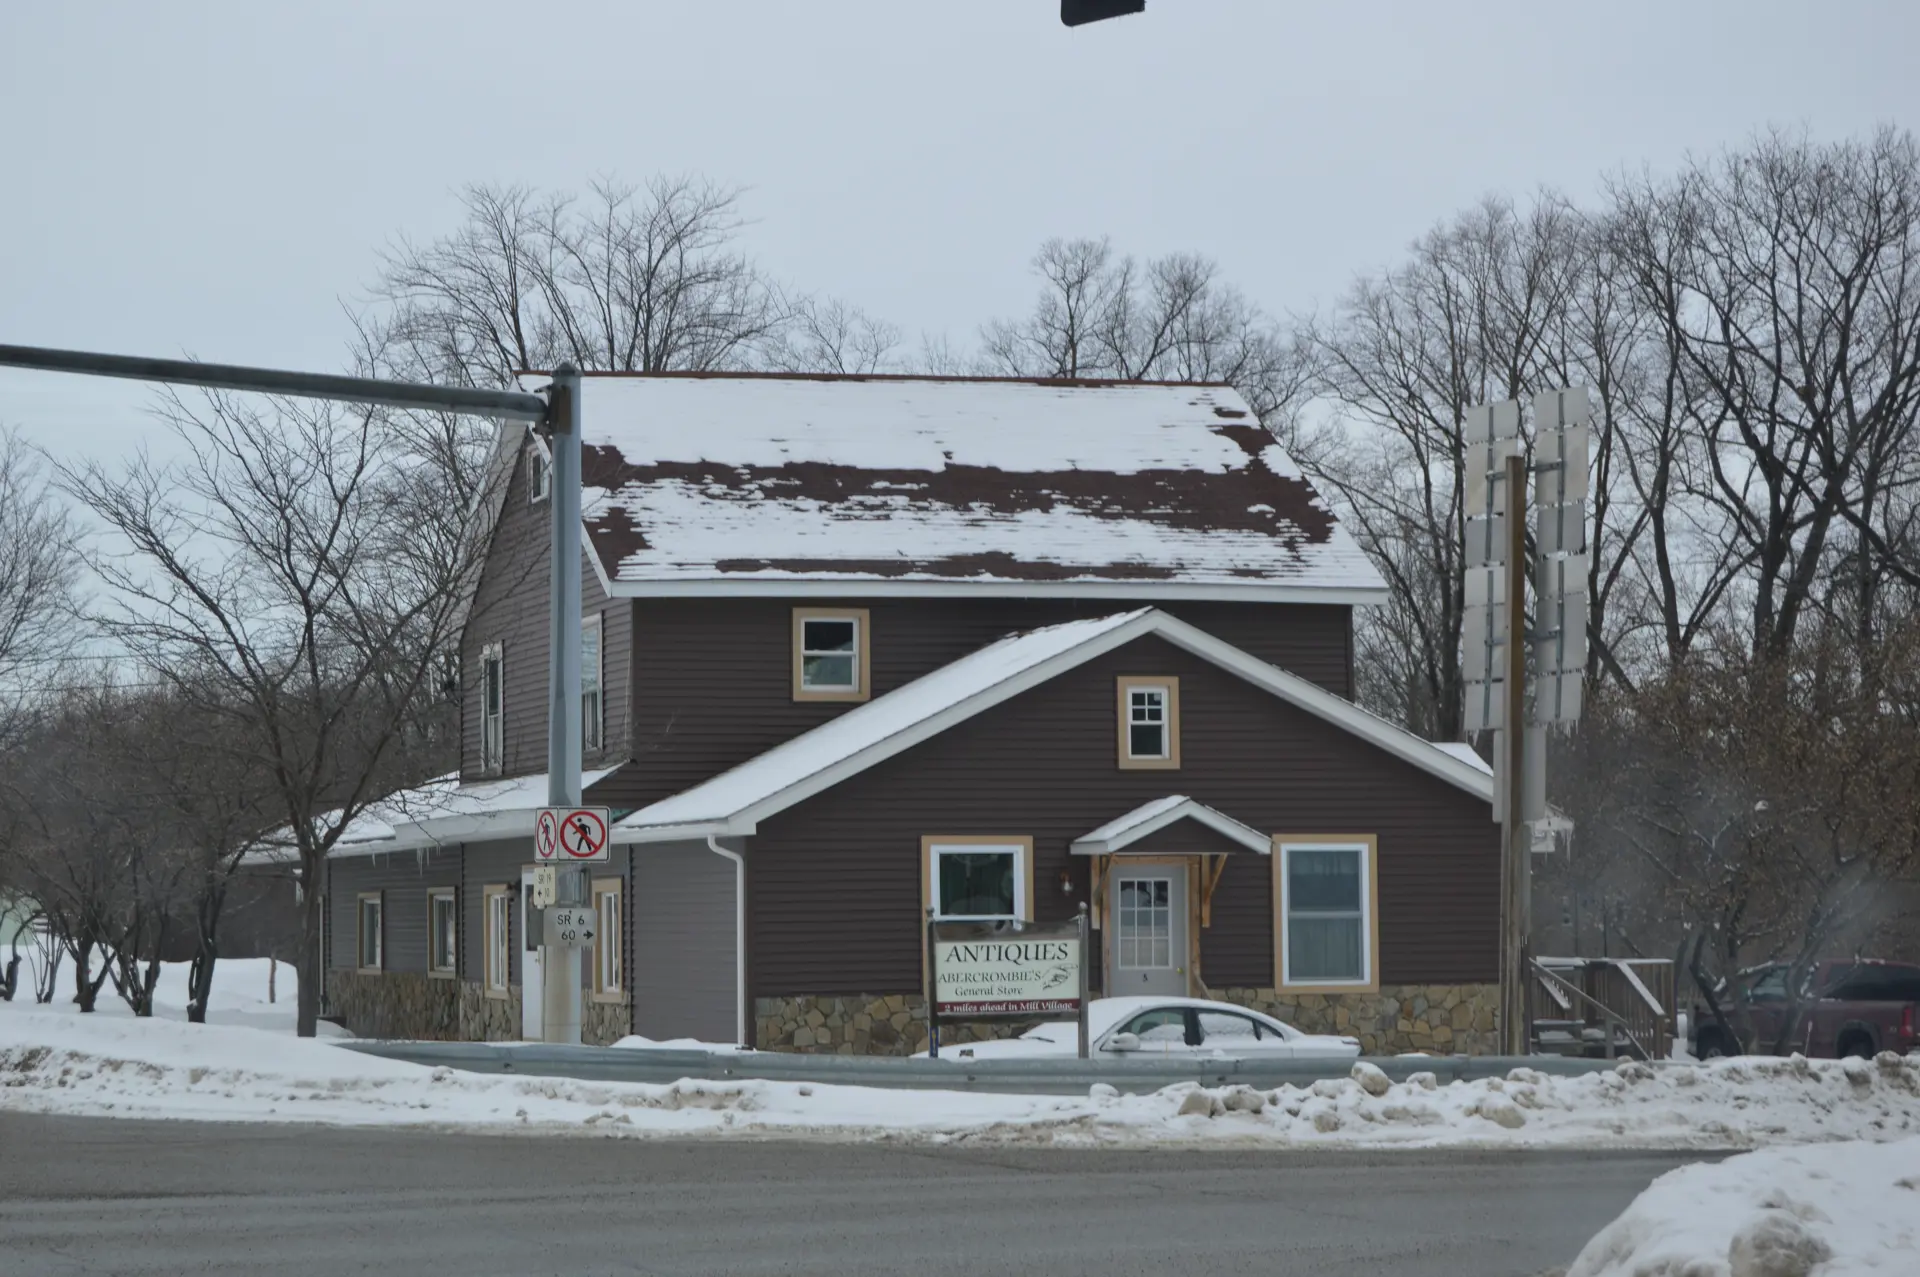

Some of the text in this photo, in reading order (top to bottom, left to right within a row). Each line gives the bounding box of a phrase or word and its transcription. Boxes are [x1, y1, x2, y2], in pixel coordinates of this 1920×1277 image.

[557, 914, 585, 925] SR 6
[561, 929, 576, 941] 60
[944, 942, 1069, 966] ANTIQUES
[938, 969, 1041, 984] ABERCROMBIE'S
[954, 985, 1023, 997] General Store
[953, 1002, 977, 1013] miles
[979, 1002, 1006, 1012] ahead
[1008, 1002, 1018, 1012] in
[1019, 1001, 1039, 1011] Mill
[1041, 1000, 1073, 1011] Village
